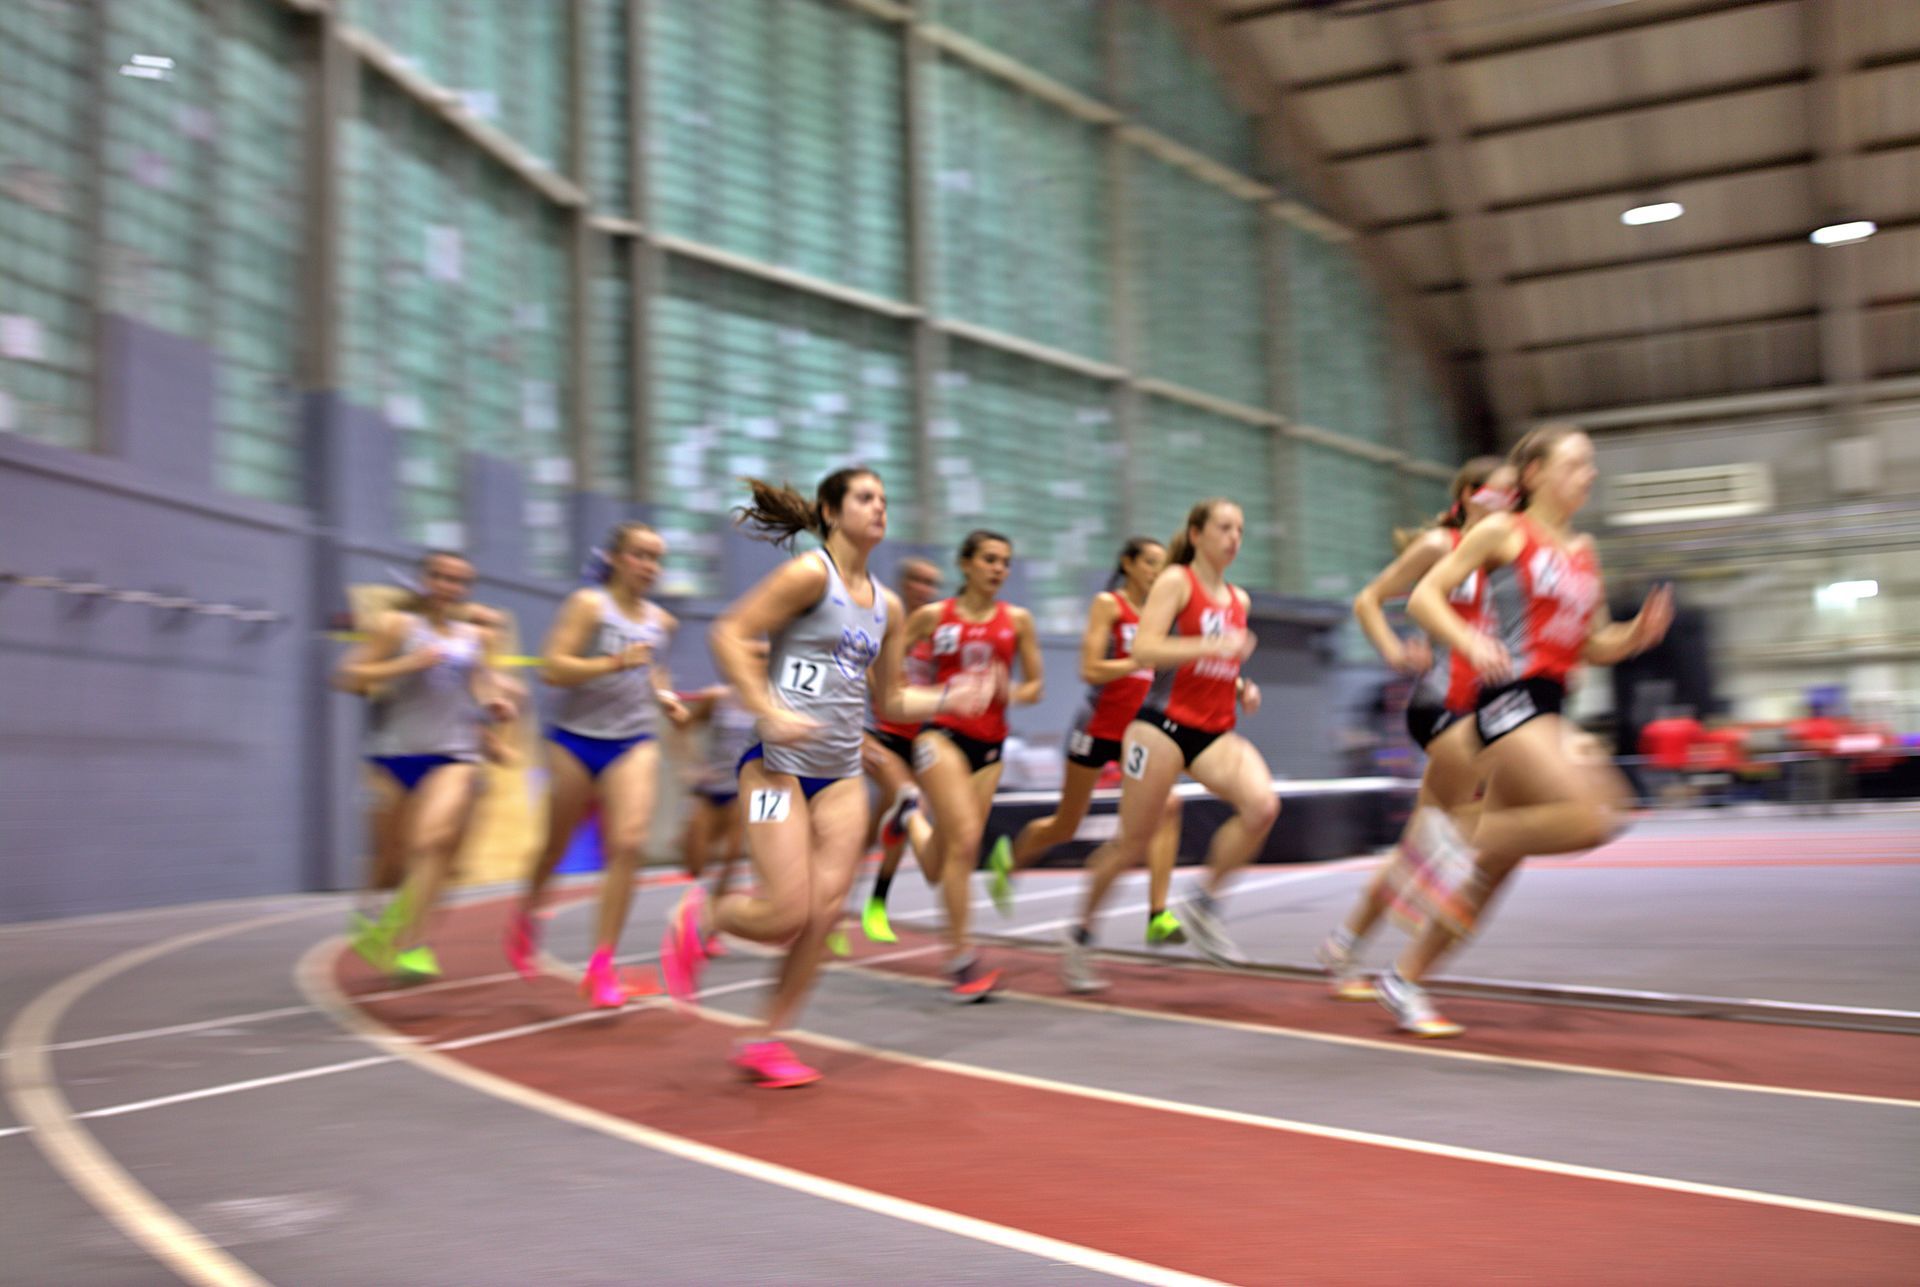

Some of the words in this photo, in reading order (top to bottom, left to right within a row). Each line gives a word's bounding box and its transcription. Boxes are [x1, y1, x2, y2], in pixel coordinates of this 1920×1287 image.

[791, 662, 818, 692] 12
[1128, 747, 1143, 774] 3
[758, 792, 782, 819] 12
